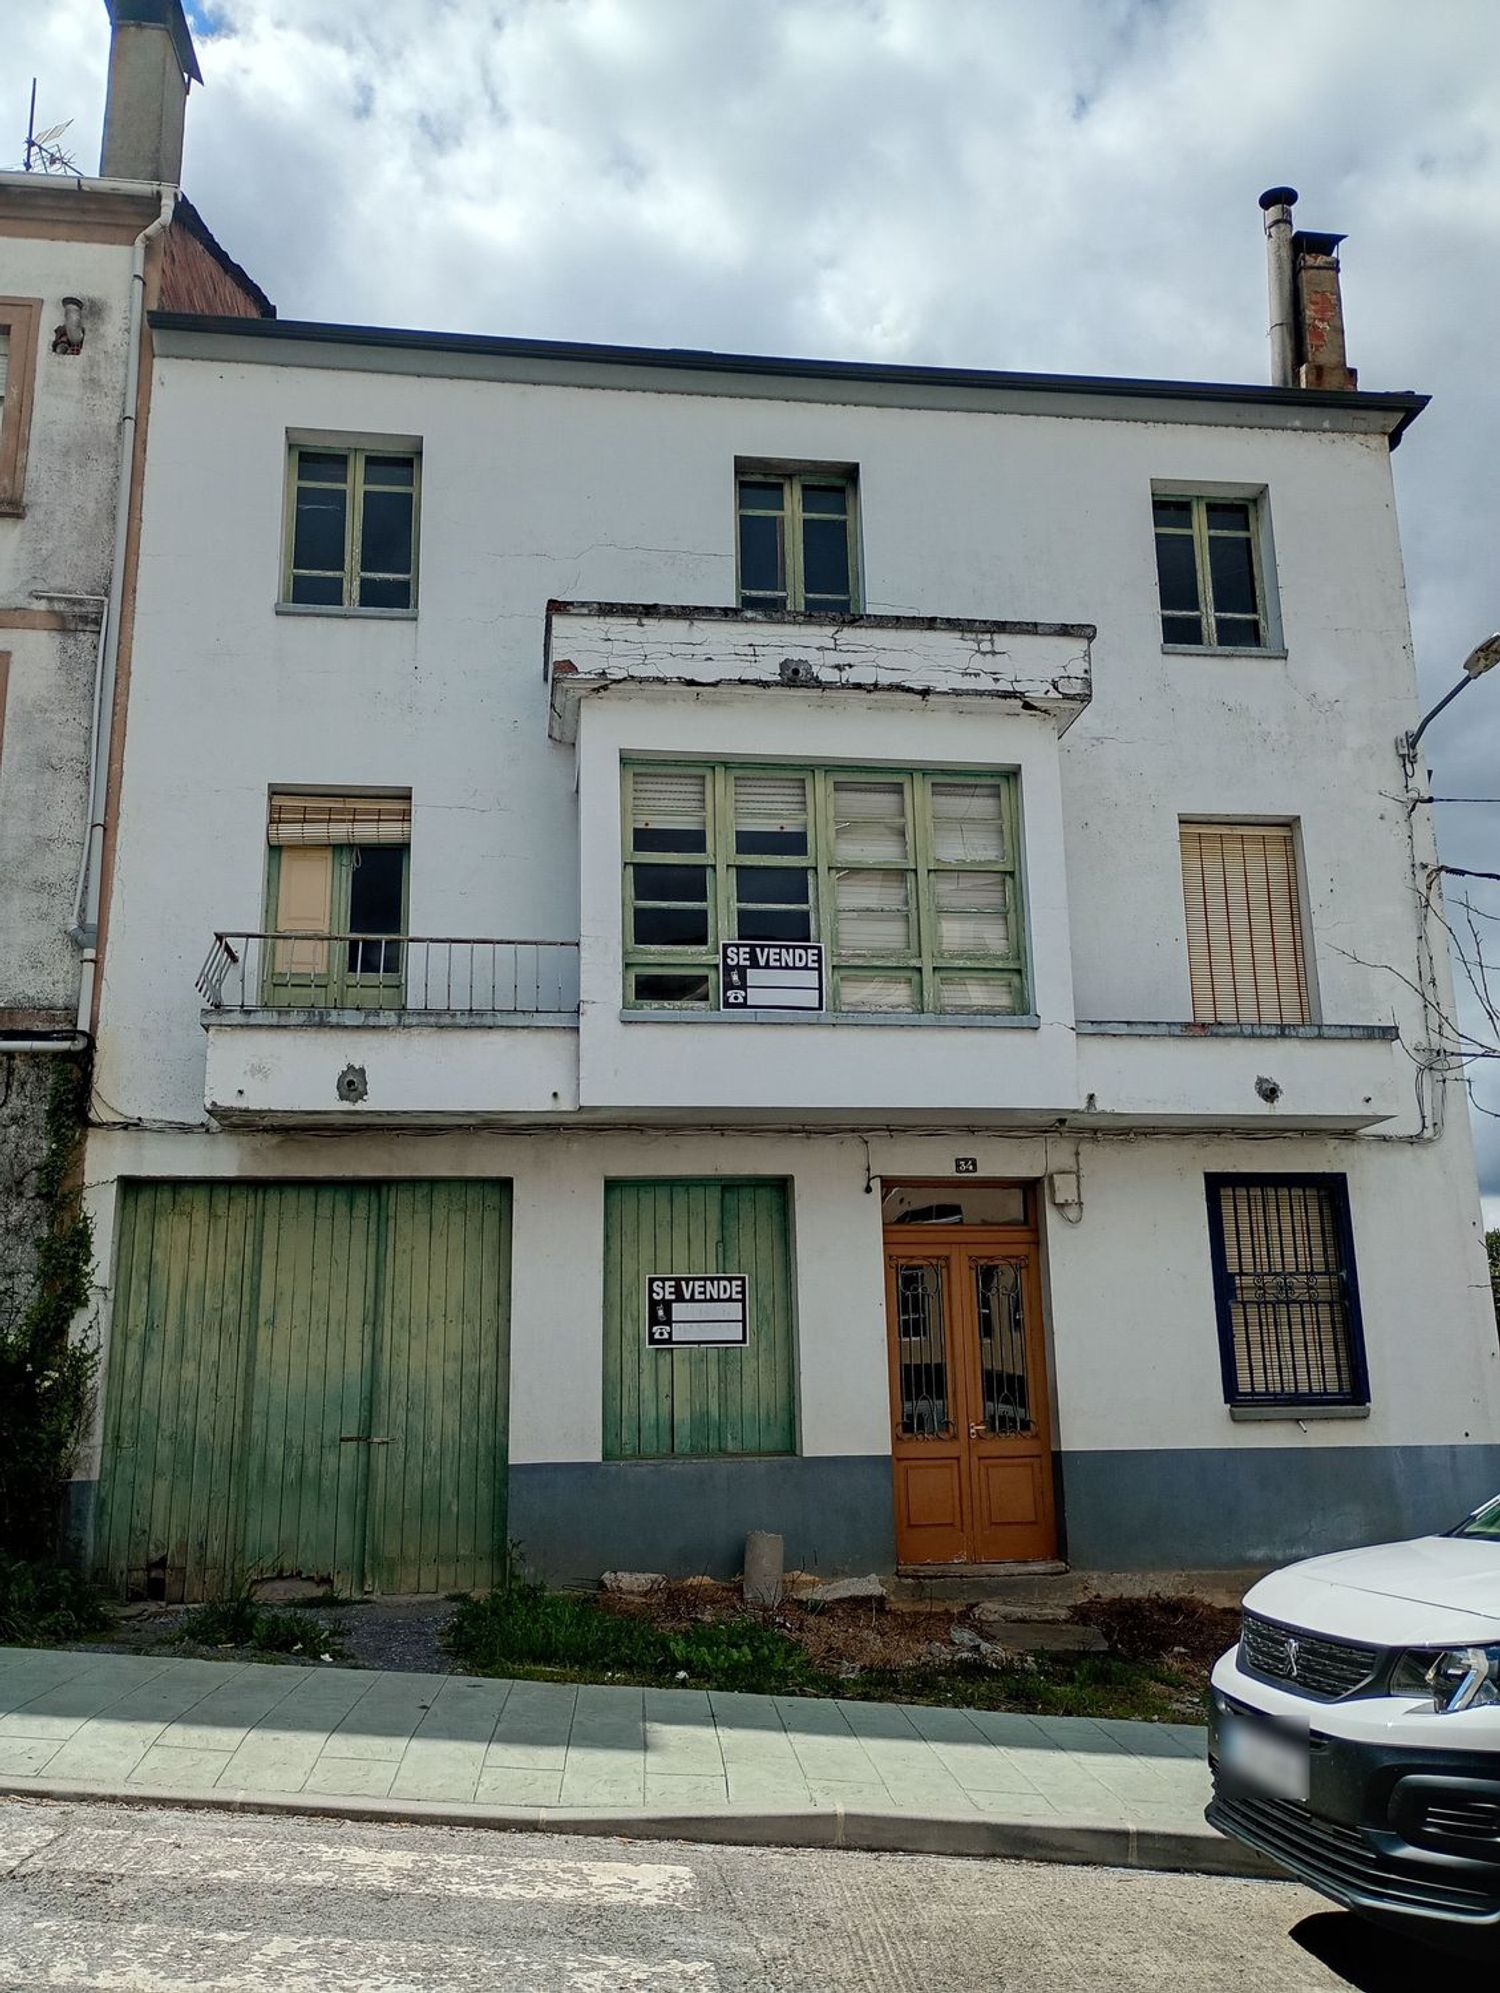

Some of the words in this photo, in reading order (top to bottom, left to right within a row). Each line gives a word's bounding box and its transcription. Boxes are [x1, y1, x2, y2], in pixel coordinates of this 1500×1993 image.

[726, 946, 750, 966] SE
[756, 947, 818, 967] VENDE
[959, 1160, 973, 1171] 34
[652, 1280, 676, 1300] SE
[681, 1280, 742, 1300] VENDE
